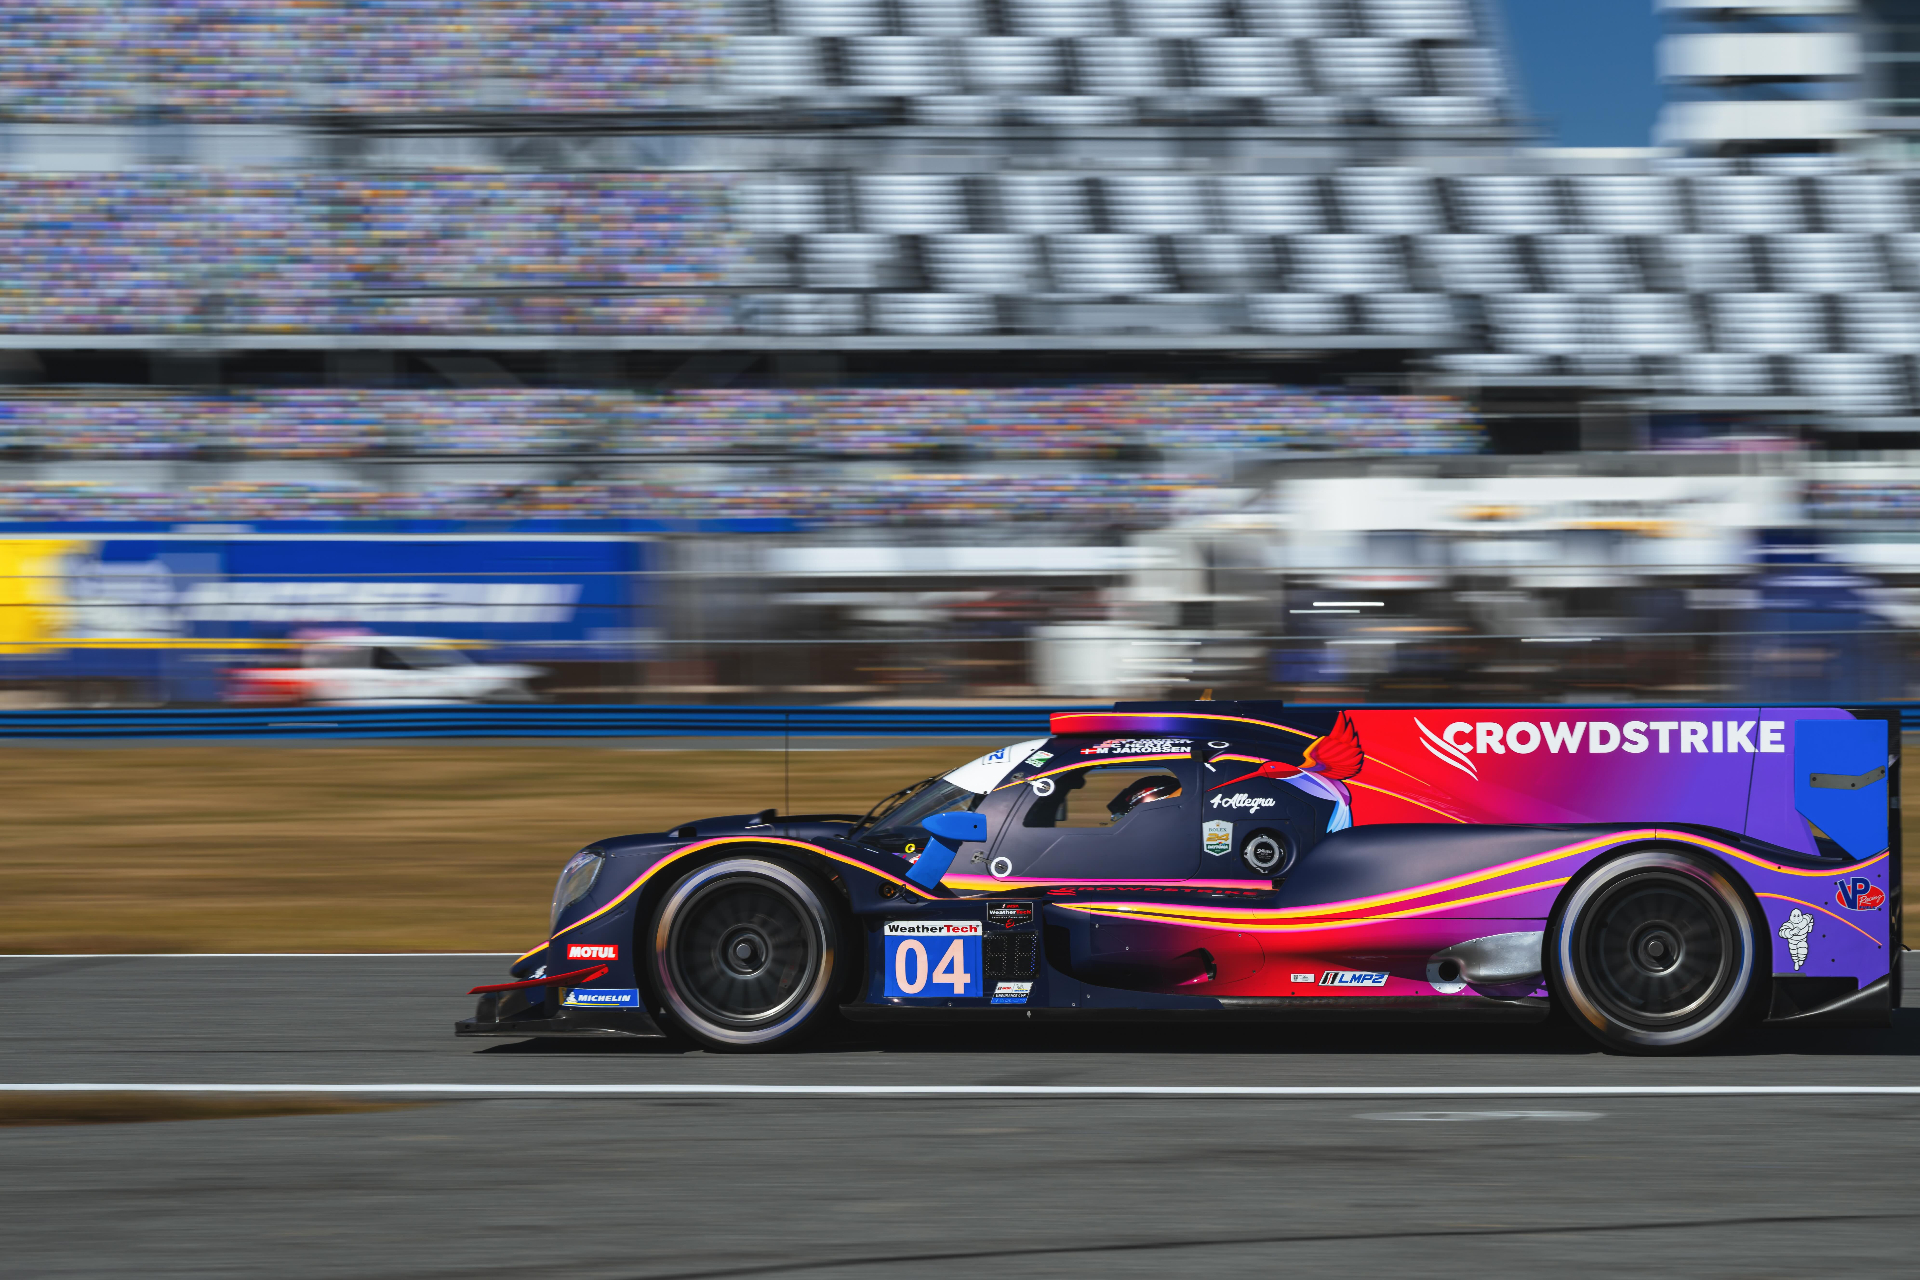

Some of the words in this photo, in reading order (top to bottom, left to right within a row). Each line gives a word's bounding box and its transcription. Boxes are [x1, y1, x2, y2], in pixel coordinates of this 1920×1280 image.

[1443, 721, 1785, 754] CROWDSTRIKE
[1206, 833, 1230, 842] 24
[1837, 877, 1871, 910] VP
[888, 924, 979, 933] WeatherTech
[569, 946, 616, 958] MOTUL
[895, 938, 971, 995] 04
[1337, 973, 1385, 984] LMP2
[577, 994, 631, 1002] MICHELIN
